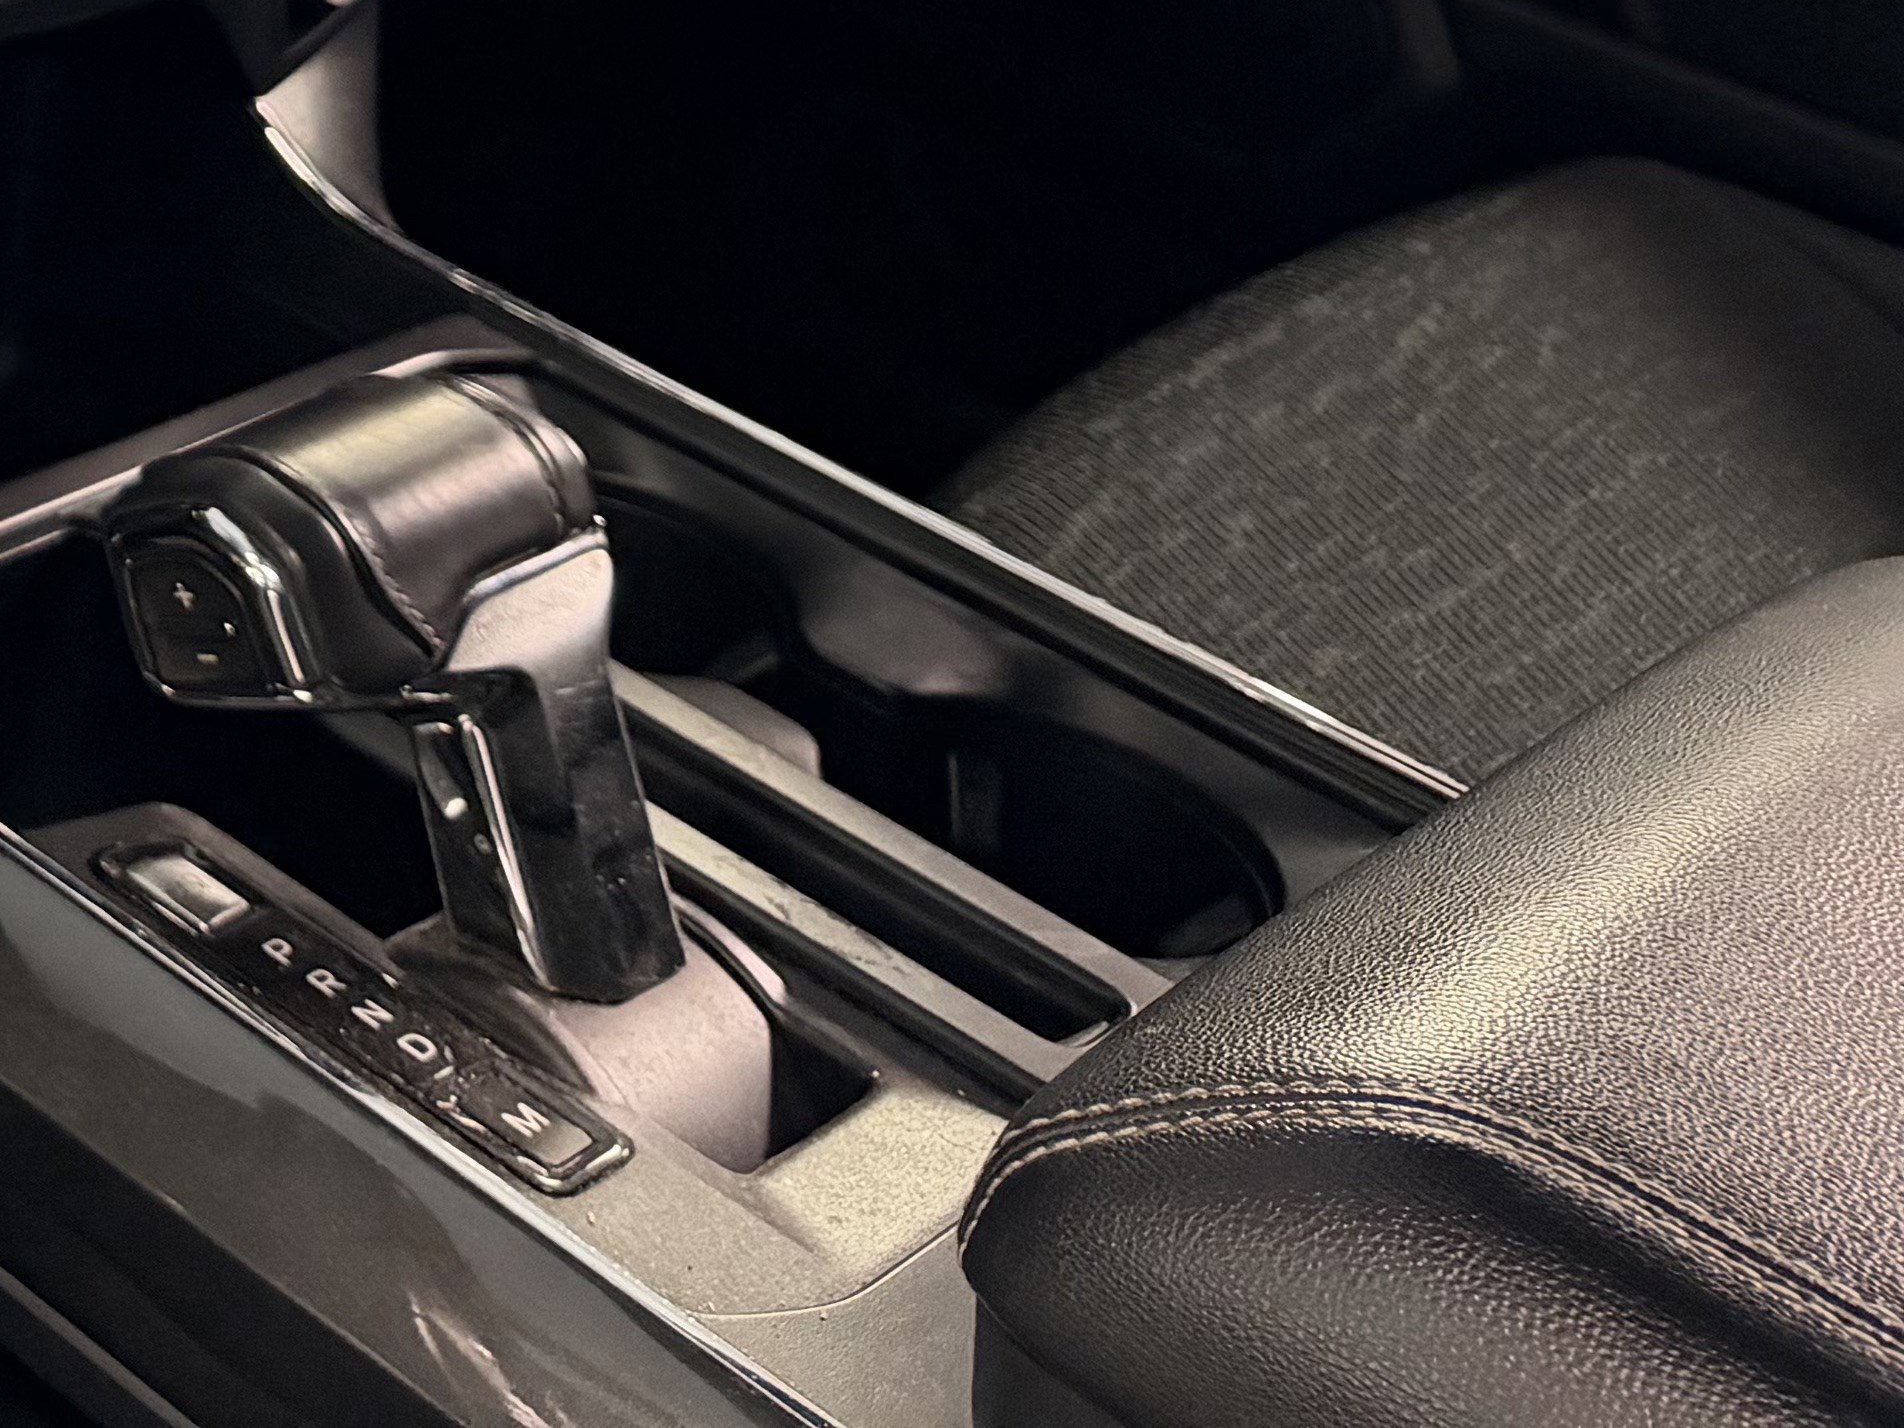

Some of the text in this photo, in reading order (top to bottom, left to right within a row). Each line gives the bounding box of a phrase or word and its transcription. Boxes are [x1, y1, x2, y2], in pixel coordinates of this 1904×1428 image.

[261, 937, 294, 968] P
[305, 968, 347, 999] R
[351, 998, 395, 1031] N
[397, 1032, 438, 1063] D
[501, 1101, 551, 1138] M
